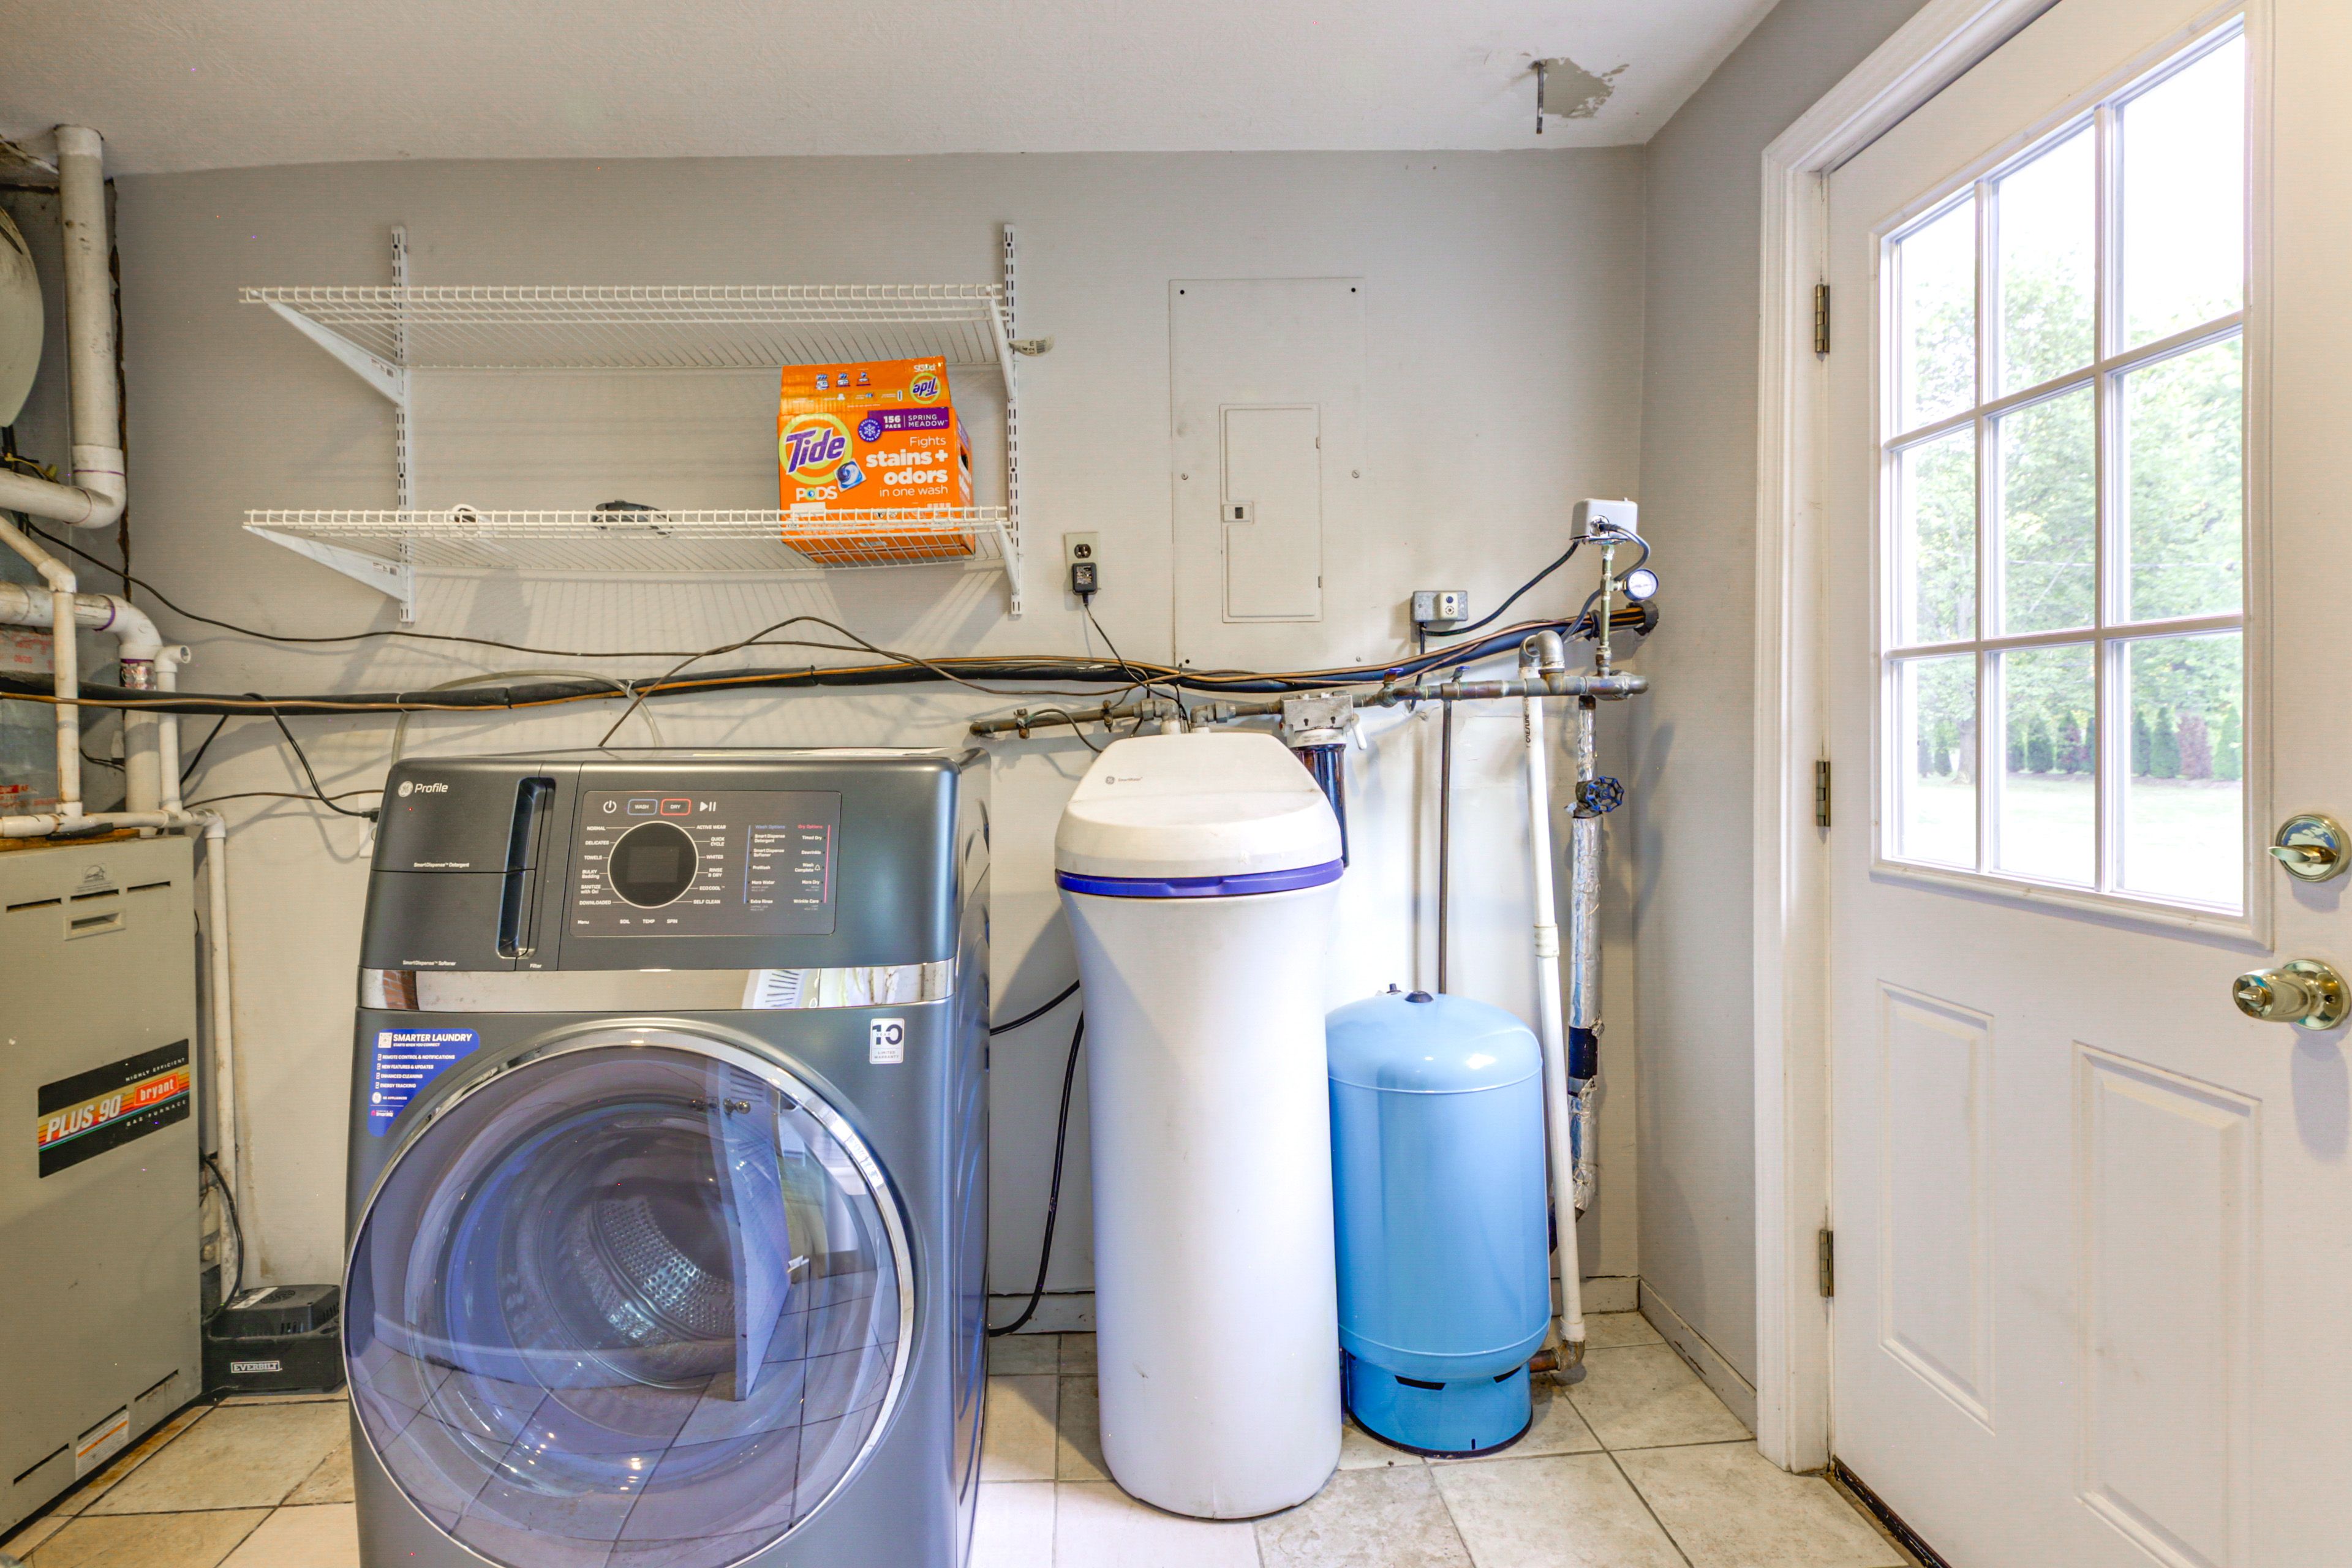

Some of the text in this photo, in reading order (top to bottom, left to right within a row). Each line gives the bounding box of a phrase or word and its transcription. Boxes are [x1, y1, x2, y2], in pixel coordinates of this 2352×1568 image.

[912, 377, 938, 397] Tide
[785, 428, 846, 475] Tide
[910, 436, 946, 448] Fights
[865, 448, 933, 467] stains
[883, 467, 948, 485] odors
[796, 486, 838, 501] PODS
[879, 484, 948, 497] in one wash
[415, 783, 448, 793] Profile
[872, 1024, 903, 1045] 10
[126, 1057, 185, 1082] HIGHLY EFFICIENT
[140, 1079, 174, 1101] bryant
[45, 1095, 123, 1142] PLUS 90
[126, 1100, 186, 1126] GAS FURNACE
